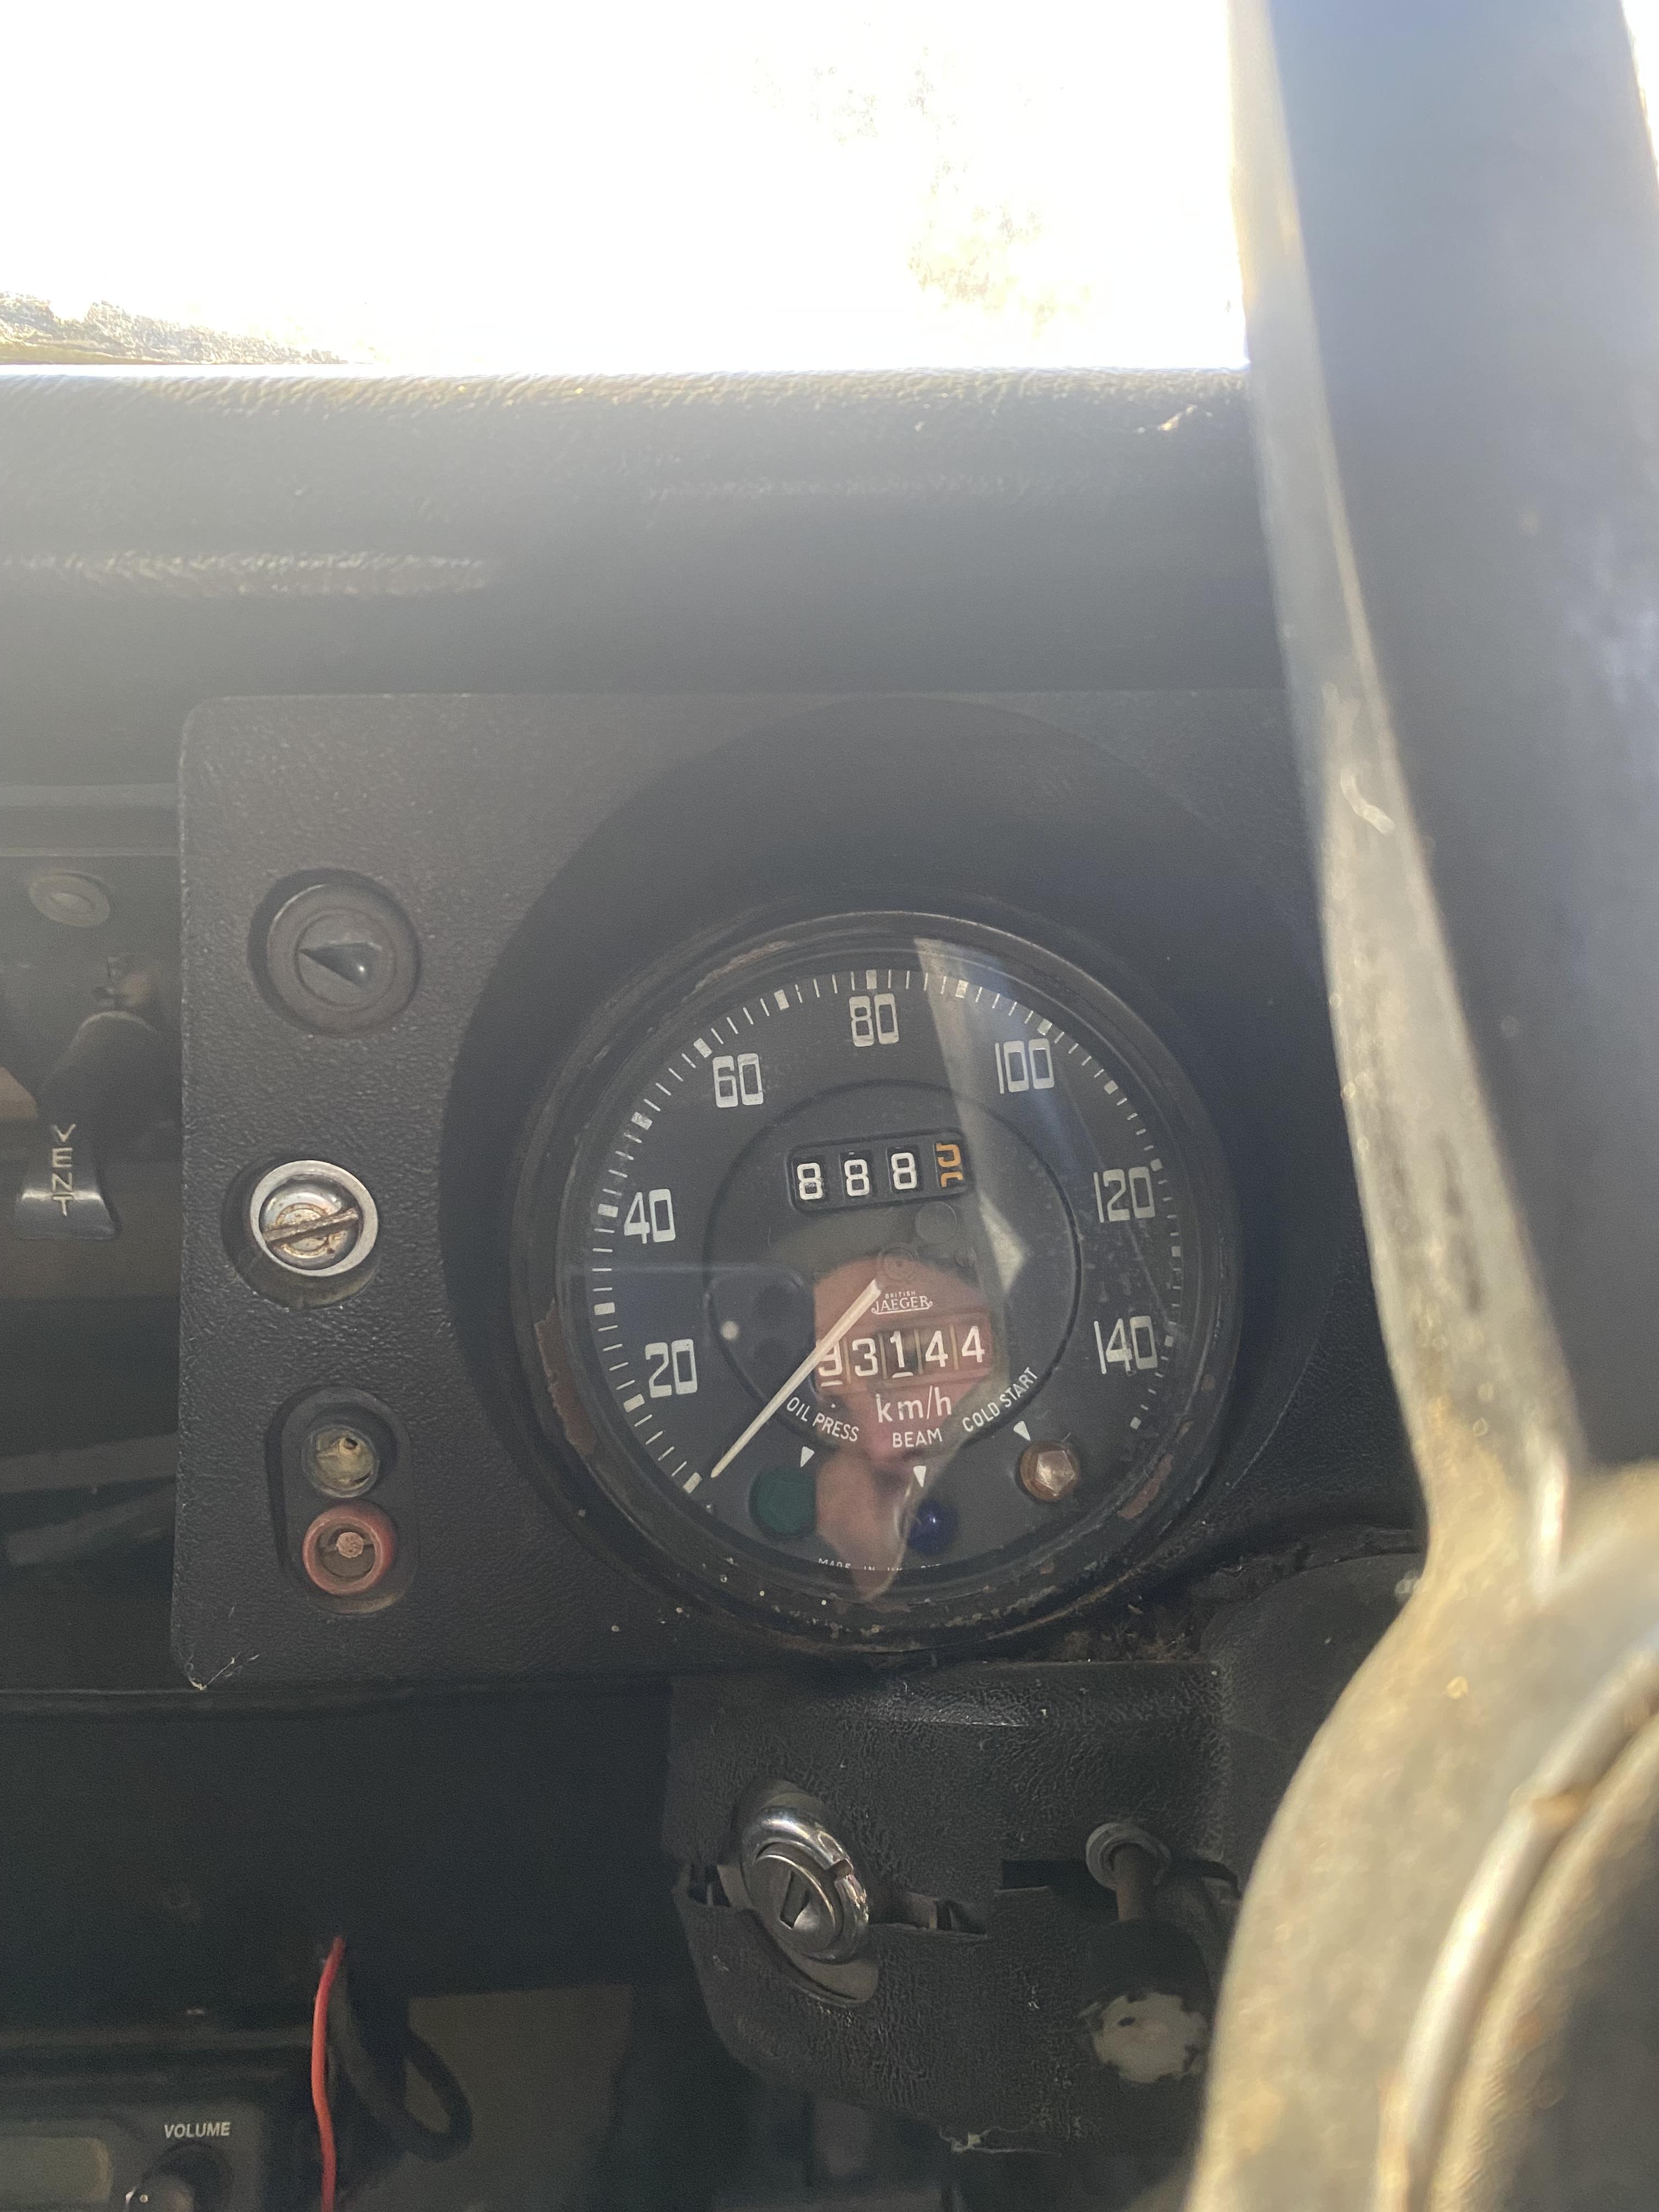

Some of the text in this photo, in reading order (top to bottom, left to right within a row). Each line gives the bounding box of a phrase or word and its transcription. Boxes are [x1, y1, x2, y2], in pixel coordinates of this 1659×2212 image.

[849, 994, 899, 1047] 80
[713, 1053, 764, 1108] 60
[995, 1039, 1054, 1094] 100
[52, 1124, 77, 1216] VENT
[1094, 1167, 1155, 1223] 120
[624, 1189, 676, 1244] 40
[871, 1295, 933, 1314] JAEGER
[885, 1290, 916, 1300] BRITISH
[645, 1339, 698, 1397] 20
[1094, 1316, 1158, 1374] 140
[786, 1397, 860, 1442] OIL PRESS
[876, 1385, 952, 1424] km/h
[962, 1367, 1038, 1432] COLD START
[892, 1427, 943, 1448] BEAM
[164, 2121, 231, 2138] VOLUME
